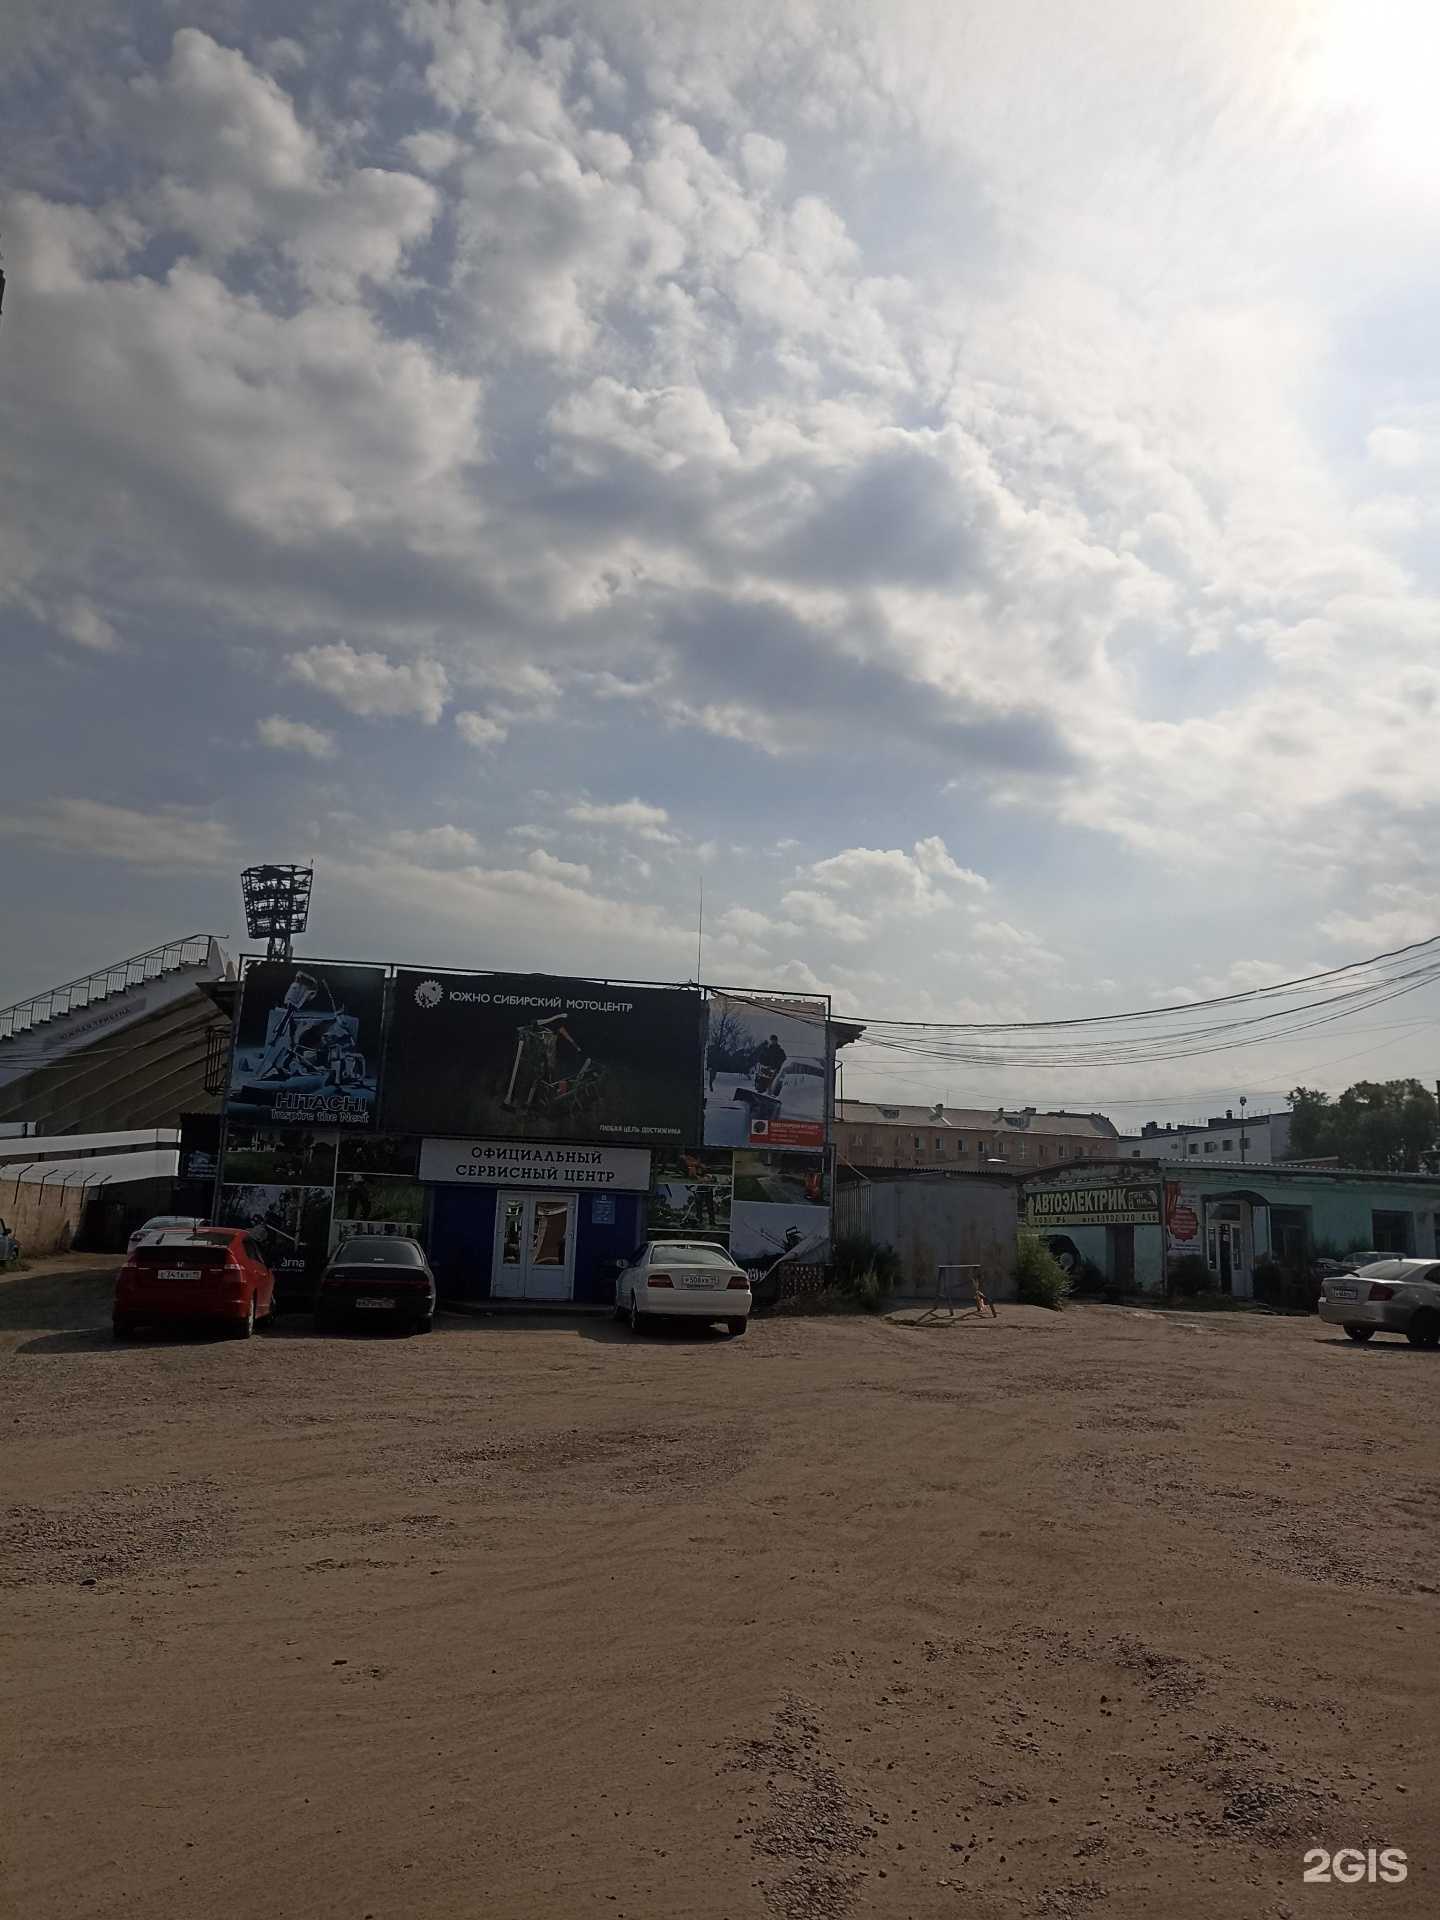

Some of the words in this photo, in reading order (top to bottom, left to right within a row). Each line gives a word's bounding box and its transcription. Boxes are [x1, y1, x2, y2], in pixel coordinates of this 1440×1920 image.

[449, 991, 491, 1003] ЮЖНО
[493, 993, 562, 1008] СИБИРСКИЙ
[566, 999, 633, 1013] МОТОЦЕНТР
[275, 1092, 368, 1112] HITACHI
[272, 1109, 315, 1122] Inspire
[317, 1110, 338, 1122] the
[340, 1111, 370, 1123] Next
[471, 1147, 603, 1164] ОФИЦИАЛЬНЫЙ
[455, 1164, 558, 1180] СЕРВИСНЫЙ
[564, 1169, 616, 1183] ЦЕНТР
[1034, 1188, 1129, 1214] АВТОЭЛЕКТРИК
